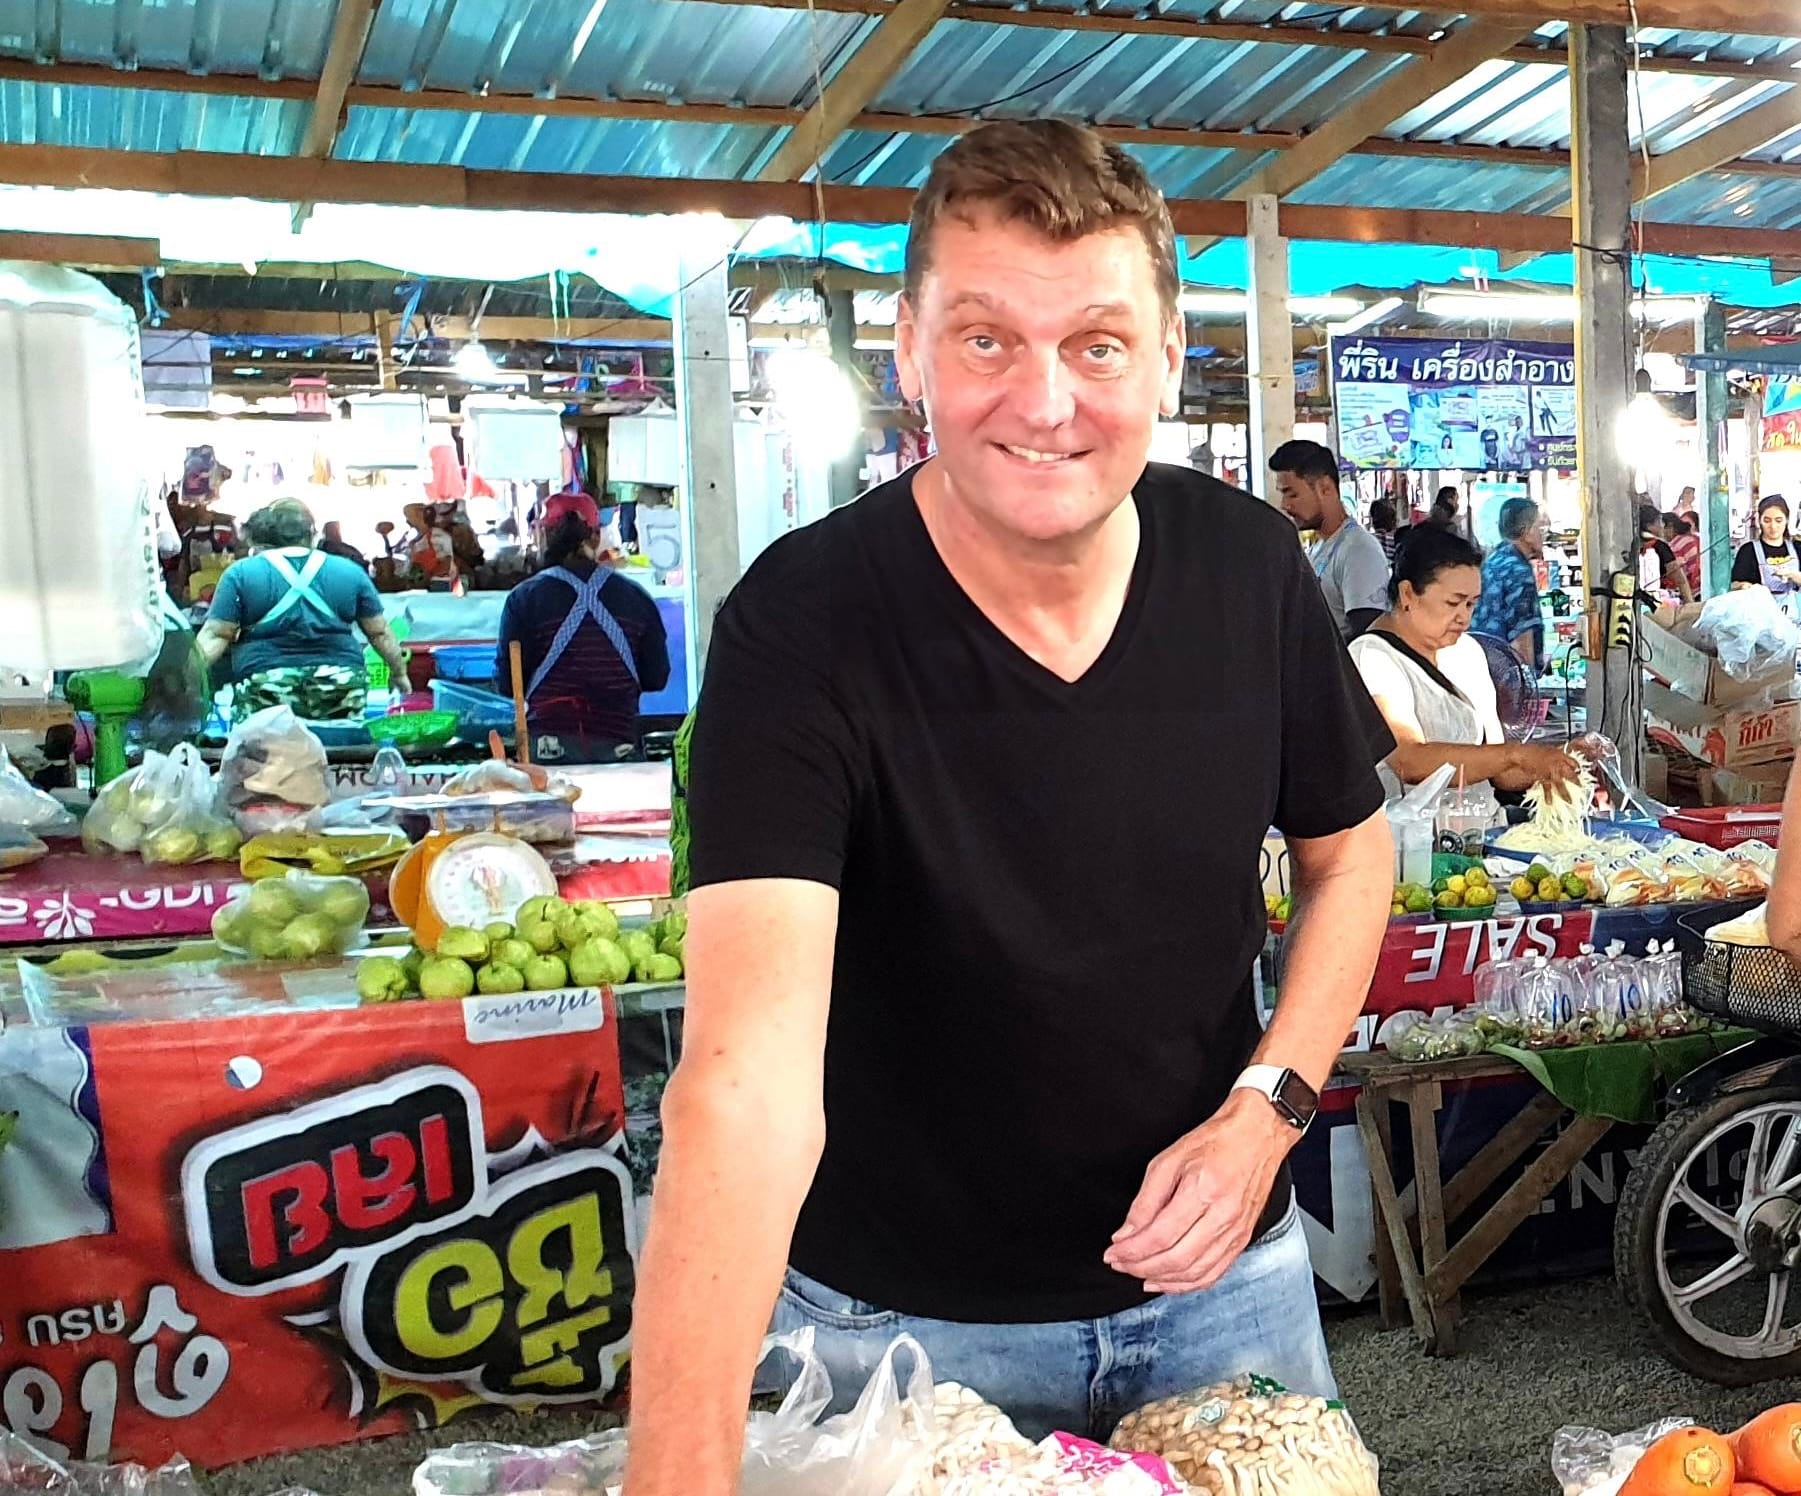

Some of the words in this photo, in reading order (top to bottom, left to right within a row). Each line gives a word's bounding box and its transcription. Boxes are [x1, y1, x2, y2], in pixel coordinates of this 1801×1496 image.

[1339, 339, 1398, 380] พี่ริน
[1413, 341, 1574, 382] เครื่องสำอาง
[1404, 913, 1563, 984] SALE
[1552, 991, 1573, 1030] 10
[1620, 982, 1642, 1019] 10
[241, 1114, 455, 1266] เลย
[396, 1192, 613, 1387] ซื้อ
[27, 1299, 127, 1347] ครบ
